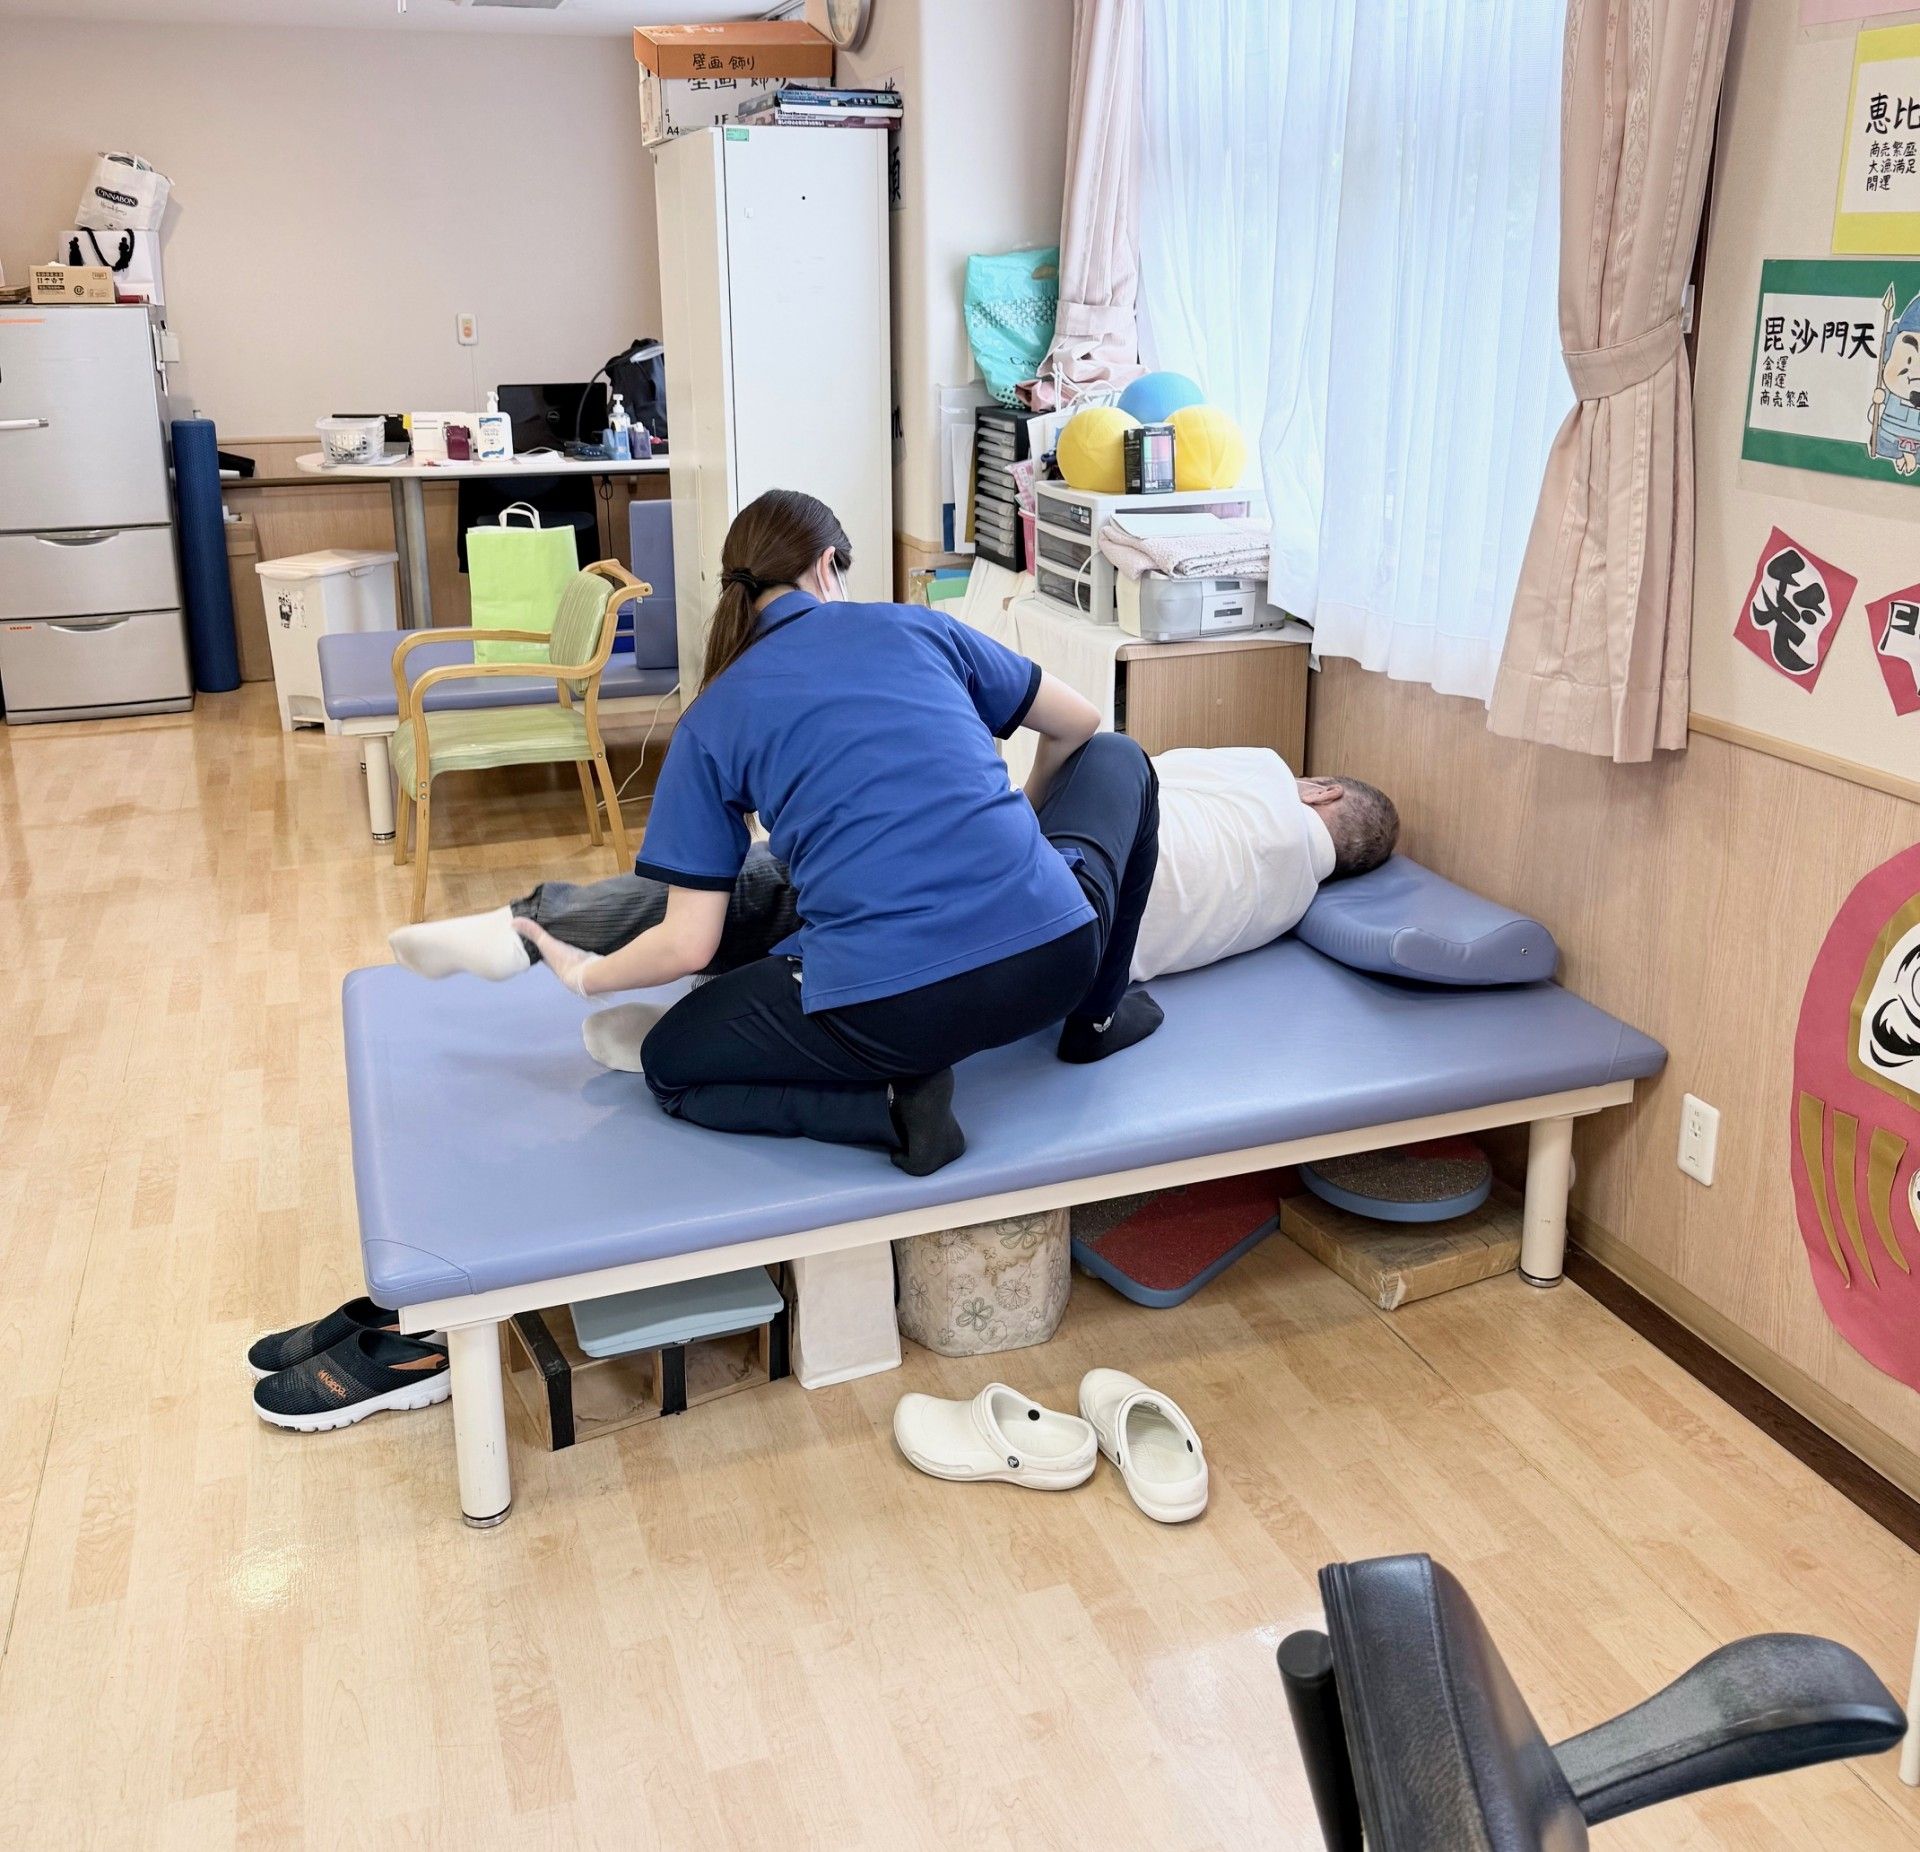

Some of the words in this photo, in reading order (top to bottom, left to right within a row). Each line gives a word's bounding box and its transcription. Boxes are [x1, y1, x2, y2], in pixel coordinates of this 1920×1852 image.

[692, 52, 724, 70] 壁画
[728, 55, 755, 70] 飾り
[667, 126, 680, 135] A4
[1869, 140, 1917, 158] 商売繁盛
[1868, 158, 1917, 175] 大漁満足
[1866, 175, 1891, 192] 開運
[97, 188, 136, 206] CINNABON
[1763, 316, 1877, 360] 毘沙門天
[1762, 355, 1789, 372] 金運
[1761, 372, 1787, 389] 開運
[1760, 389, 1809, 408] 商売繁盛
